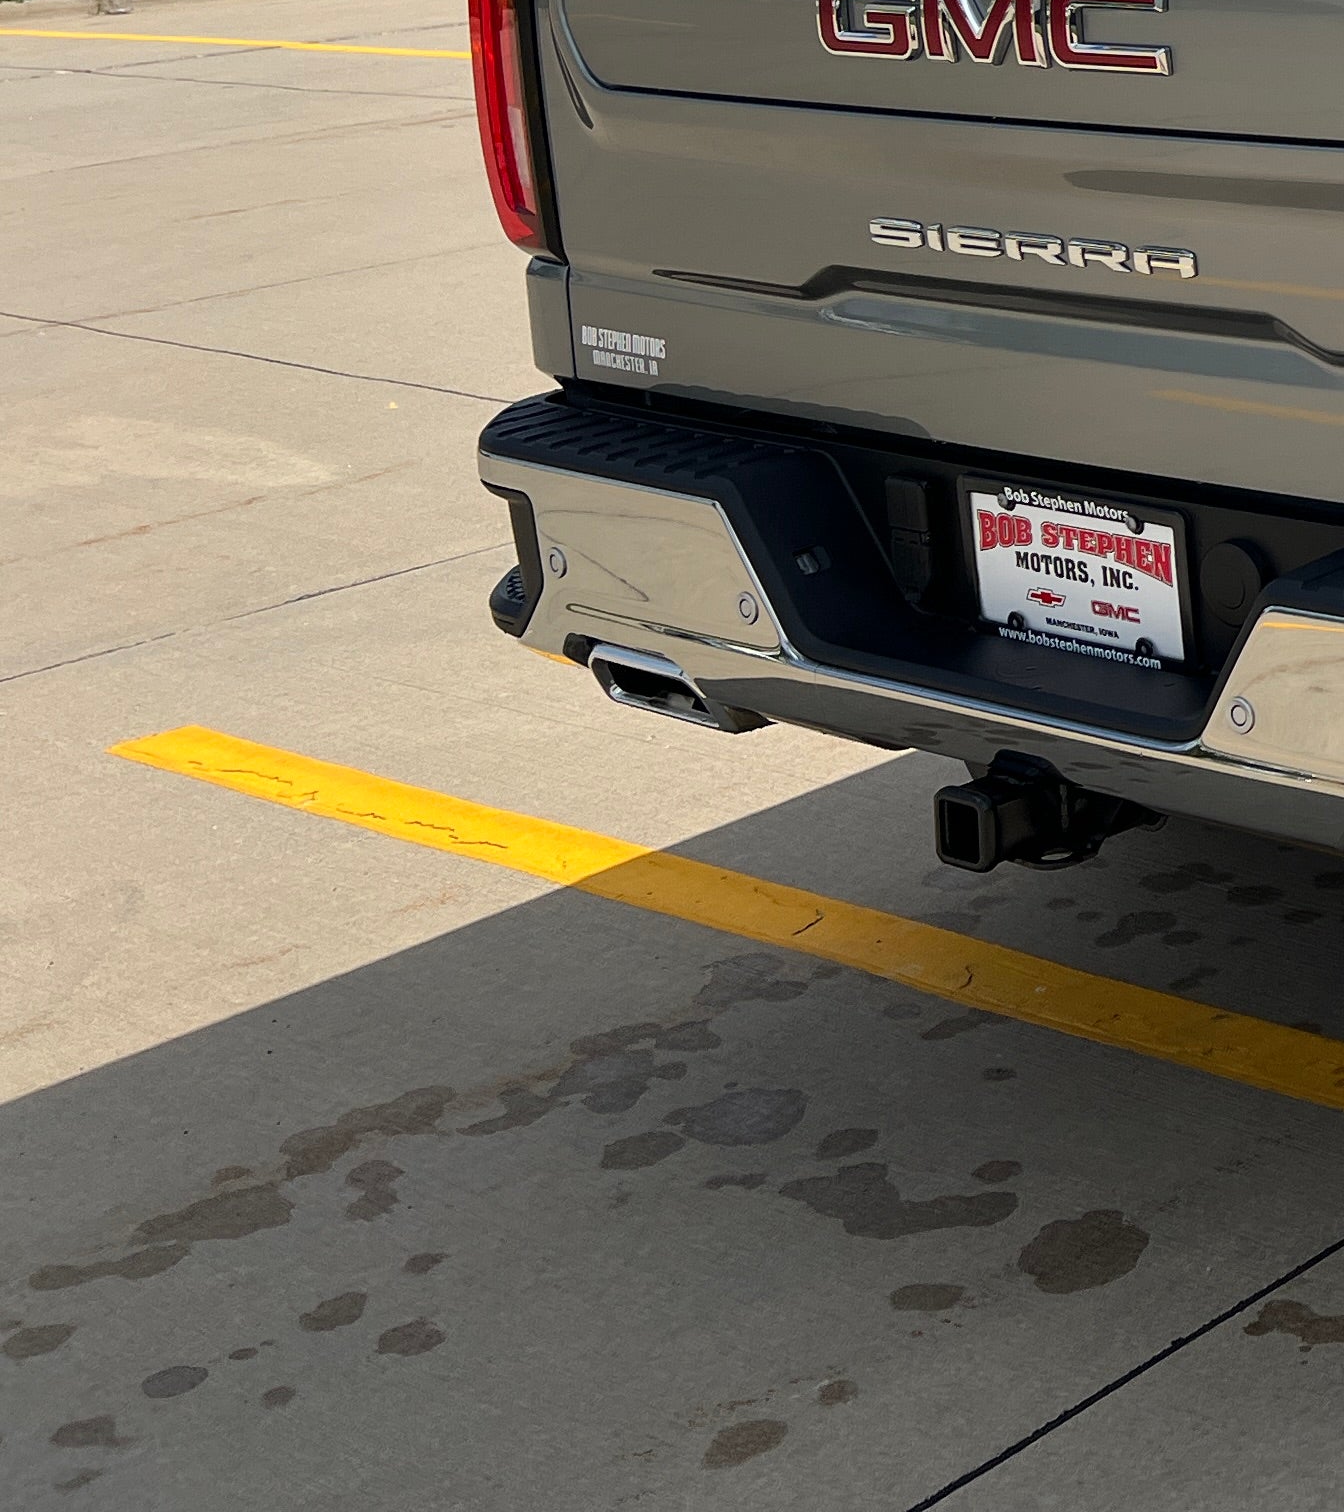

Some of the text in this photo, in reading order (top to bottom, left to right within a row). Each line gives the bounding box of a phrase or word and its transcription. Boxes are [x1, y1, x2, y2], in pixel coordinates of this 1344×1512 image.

[869, 217, 1198, 278] SIERRA
[581, 325, 666, 359] BOB STEPHEN MOTORS
[1004, 487, 1129, 521] Bob Stephen Motors
[977, 510, 1173, 587] BOB STEPHEN
[1015, 551, 1139, 591] MOTORS, INC.
[1045, 617, 1120, 639] MANCHESTER, IOWA
[1091, 599, 1141, 624] GMC
[999, 627, 1162, 670] www.bobstephenmotors.com
